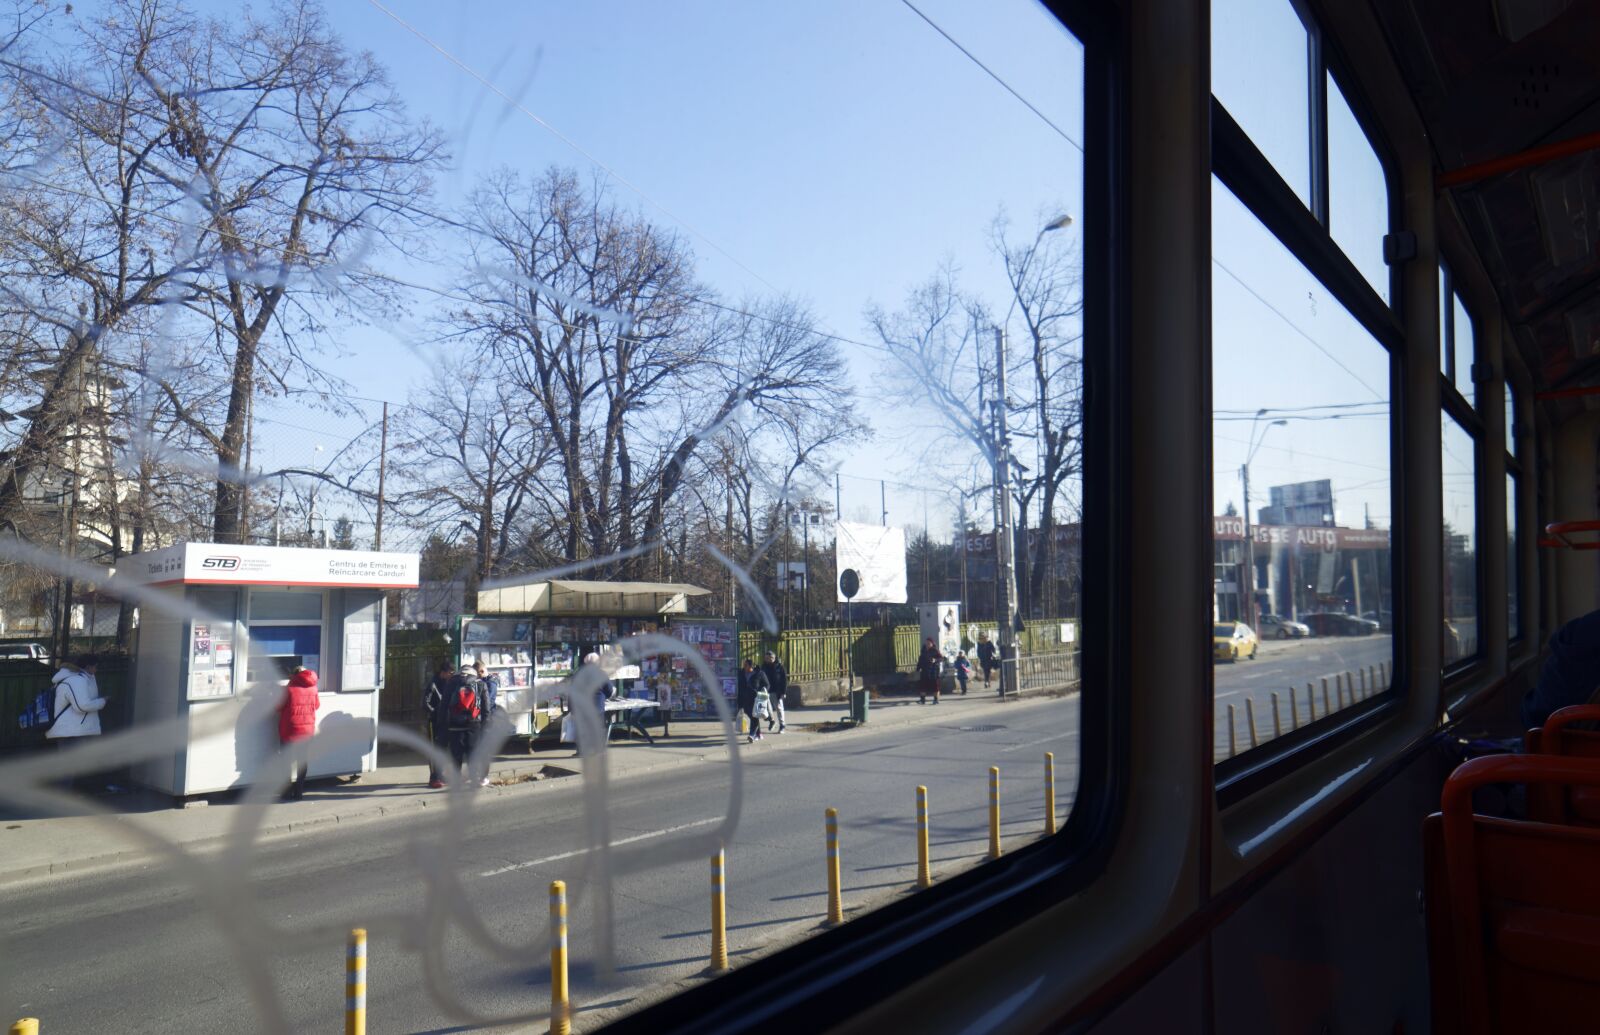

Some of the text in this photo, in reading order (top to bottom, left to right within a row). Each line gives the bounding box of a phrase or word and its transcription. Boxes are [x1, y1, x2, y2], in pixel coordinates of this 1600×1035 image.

[1214, 520, 1241, 535] UTO
[1297, 529, 1336, 545] AUTO
[202, 558, 237, 568] STB
[329, 560, 356, 568] Centru
[358, 561, 368, 569] de
